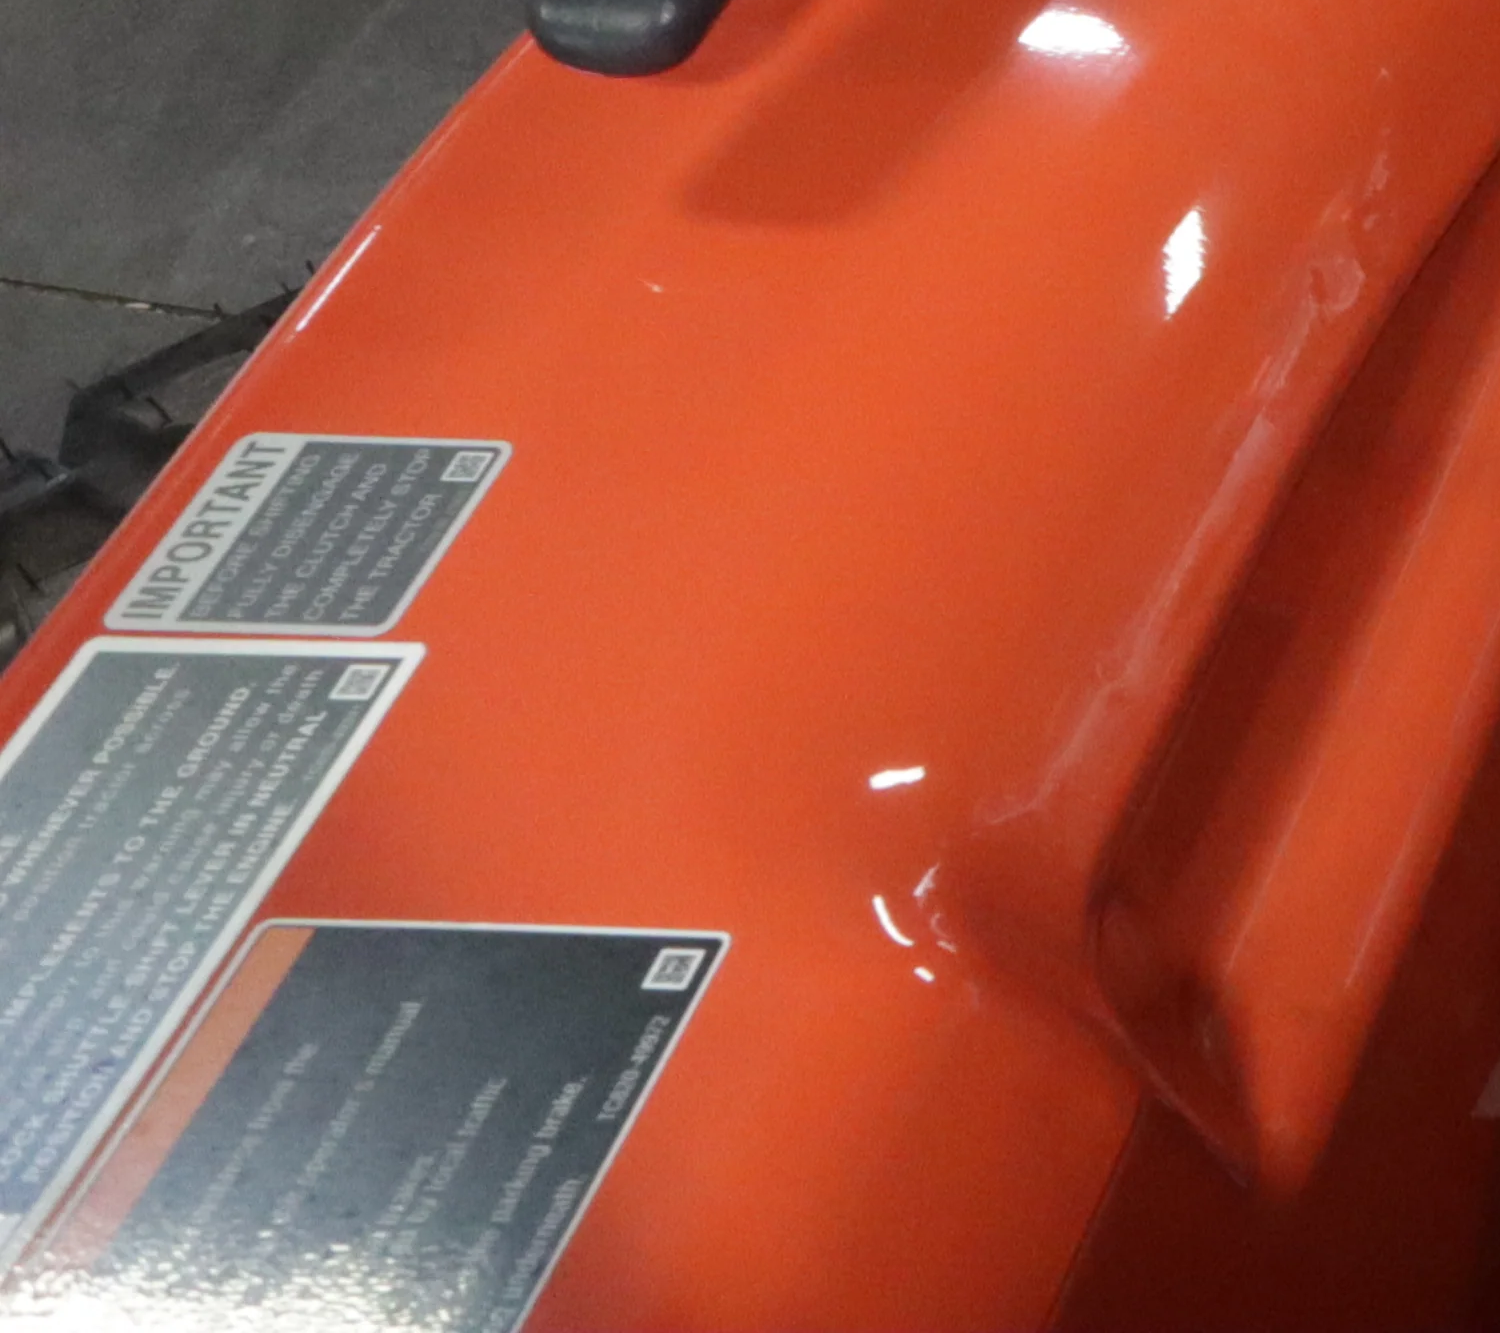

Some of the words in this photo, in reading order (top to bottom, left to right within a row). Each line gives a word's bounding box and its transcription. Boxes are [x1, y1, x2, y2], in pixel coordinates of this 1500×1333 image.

[123, 442, 283, 618] IMPORTANT
[266, 583, 304, 615] THE
[295, 504, 358, 578] CLUTCH
[351, 463, 386, 500] AND
[306, 500, 396, 618] COMPLETELY
[390, 449, 429, 495] STOP
[341, 585, 379, 618] THE
[368, 493, 441, 578] TRACTOR
[113, 835, 145, 863] TO
[139, 786, 182, 826] THE
[175, 842, 234, 914] LEVER
[249, 712, 325, 806] NEUTRAL
[109, 1007, 152, 1057] AND
[148, 940, 195, 1000] STOP
[193, 892, 233, 931] THE
